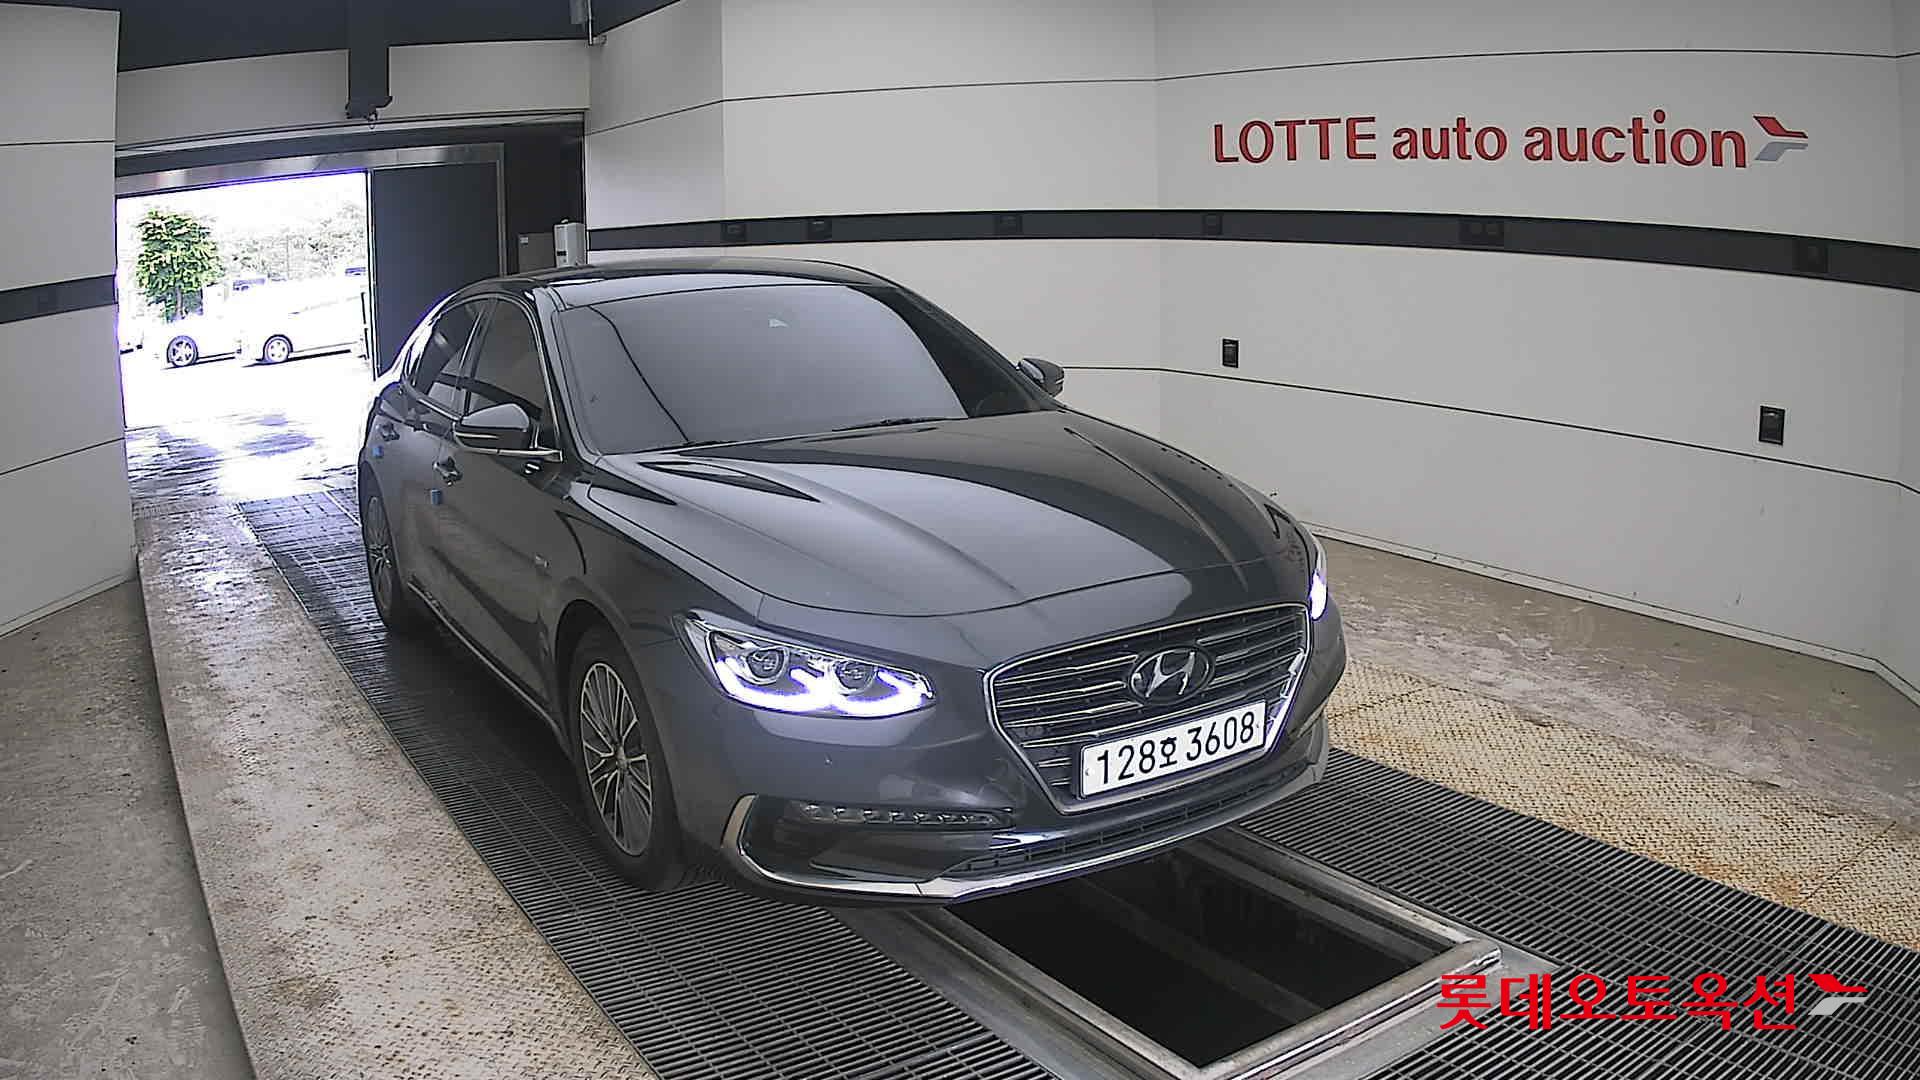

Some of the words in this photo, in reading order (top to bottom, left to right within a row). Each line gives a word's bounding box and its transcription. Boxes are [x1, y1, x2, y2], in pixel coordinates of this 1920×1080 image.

[1213, 116, 1377, 163] LOTTE
[1393, 116, 1507, 162] auto
[1523, 109, 1748, 169] auction
[1186, 711, 1255, 761] 3608
